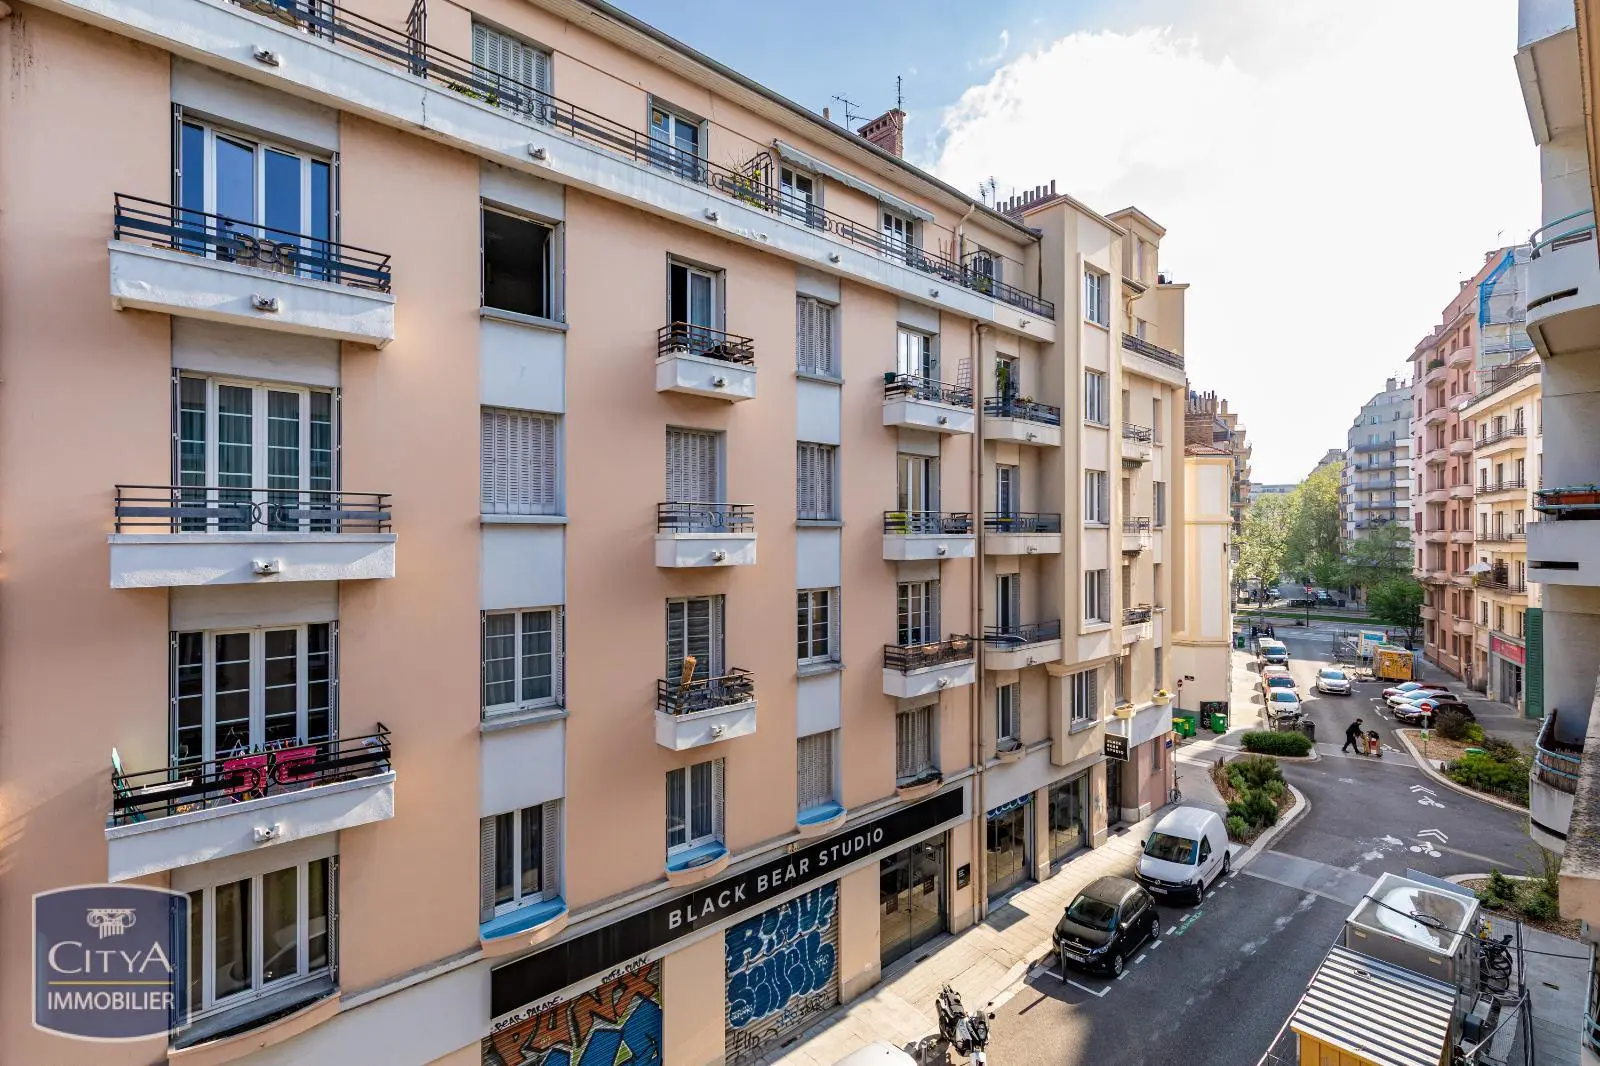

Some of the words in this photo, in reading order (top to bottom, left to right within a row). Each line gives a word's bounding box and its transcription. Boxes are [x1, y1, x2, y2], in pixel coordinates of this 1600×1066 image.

[668, 883, 747, 930] BLACK
[757, 858, 809, 893] BEAR
[818, 827, 884, 867] STUDIO
